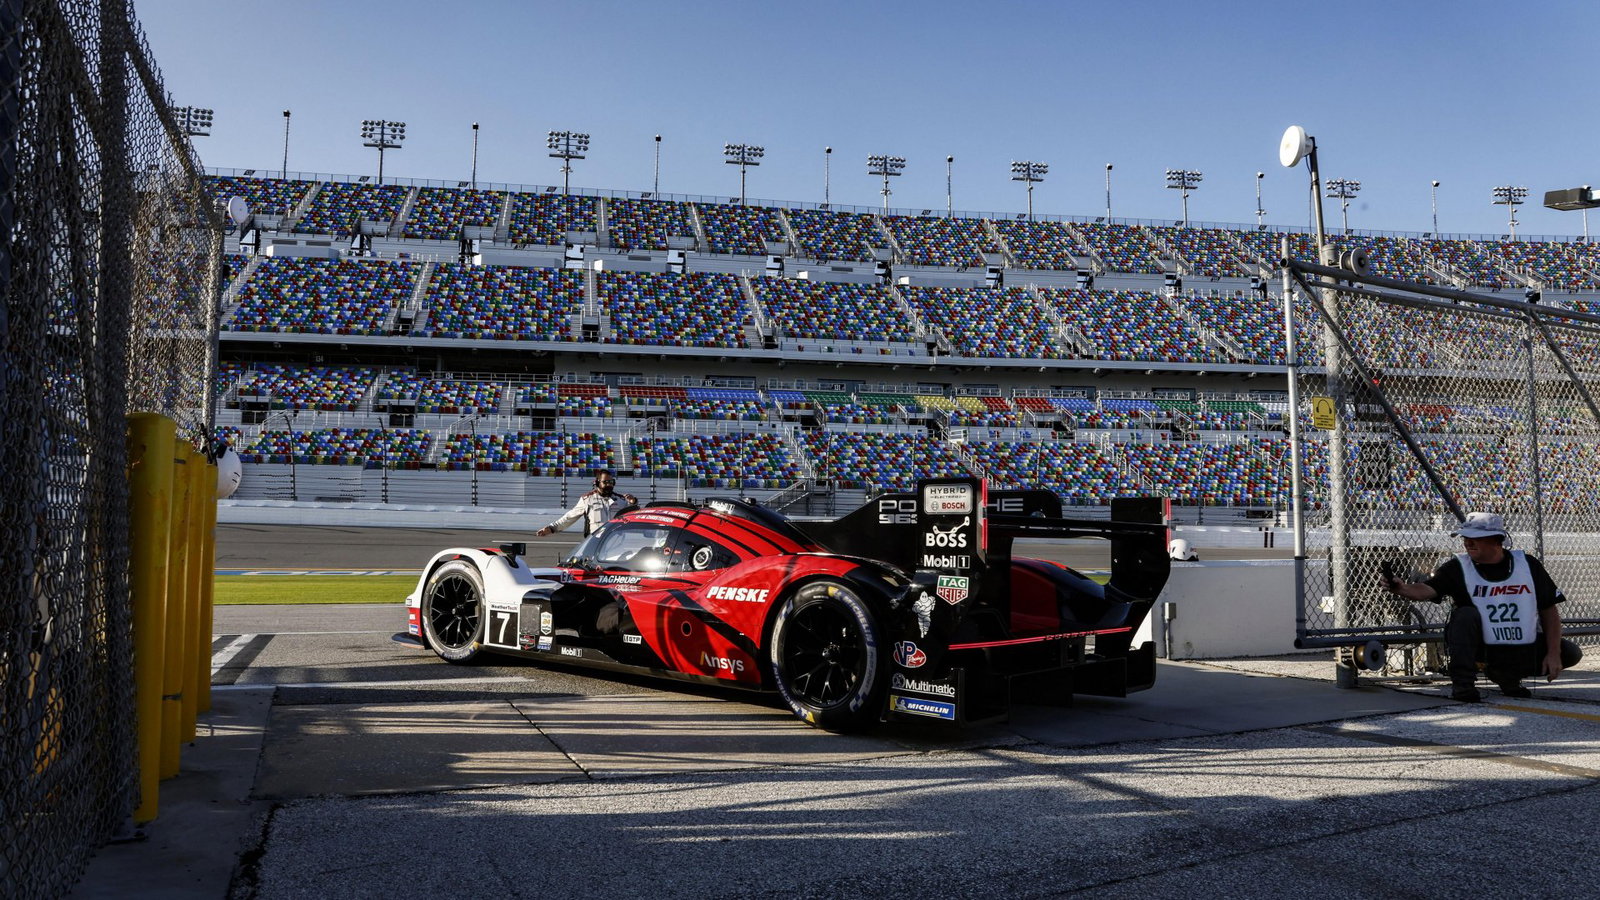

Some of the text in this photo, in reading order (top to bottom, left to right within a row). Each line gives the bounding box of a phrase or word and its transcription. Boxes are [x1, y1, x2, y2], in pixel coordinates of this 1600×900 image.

[941, 502, 966, 510] BOSCH
[925, 532, 967, 548] BOSS
[923, 554, 968, 568] Mobil 1
[941, 577, 966, 588] TAG
[706, 586, 770, 603] PENSKE
[939, 588, 966, 602] HEUER
[1489, 584, 1532, 597] IMSA
[1486, 603, 1520, 623] 222
[497, 612, 510, 643] 7
[1492, 626, 1523, 641] VIDEO
[561, 647, 576, 656] Mobil
[895, 641, 917, 667] VP
[700, 651, 745, 674] Ansys
[905, 679, 955, 695] Multimatic
[907, 703, 949, 714] MICHELIN
